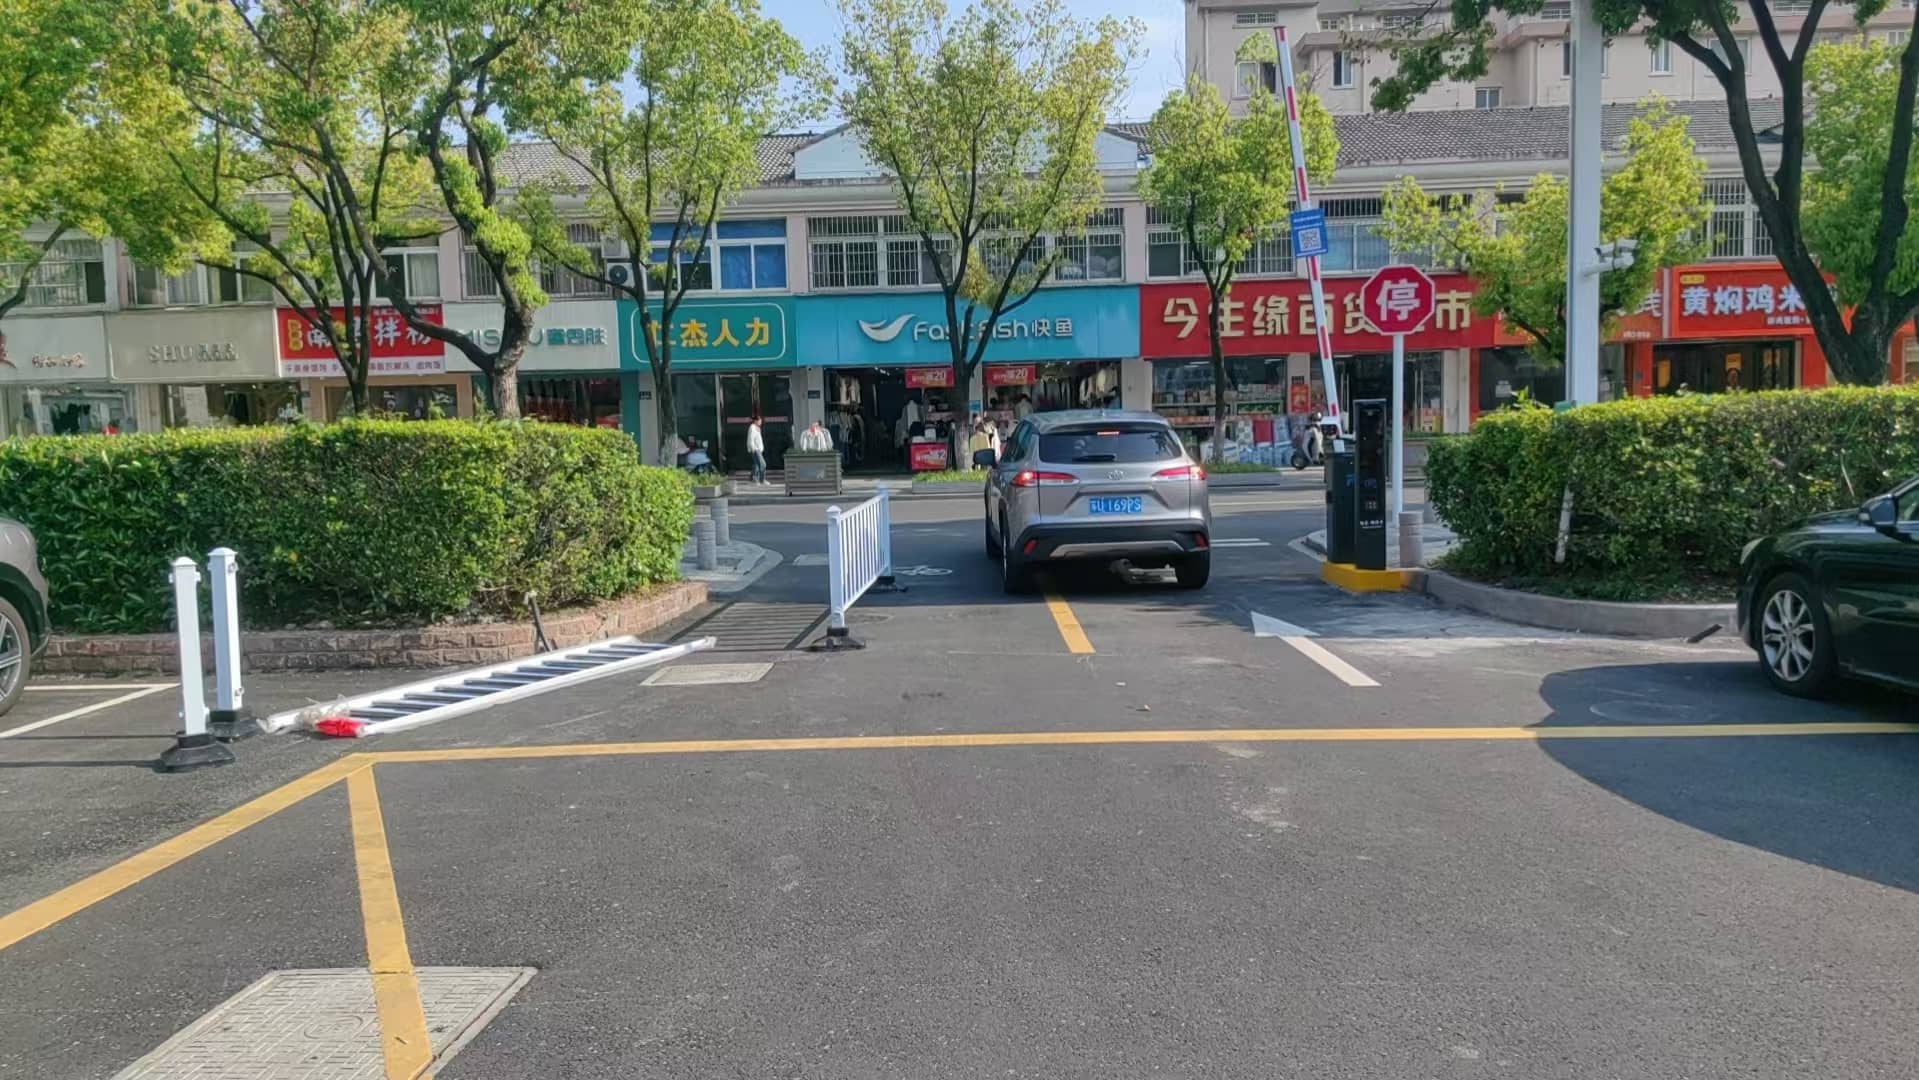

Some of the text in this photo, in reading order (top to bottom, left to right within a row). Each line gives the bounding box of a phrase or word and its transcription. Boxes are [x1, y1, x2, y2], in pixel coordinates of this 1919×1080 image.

[1163, 290, 1473, 338] 今生缘百货市
[1376, 278, 1420, 321] 停
[1682, 283, 1838, 317] 黄焖鸡米
[1032, 318, 1073, 338] 快鱼
[149, 343, 194, 362] SHU
